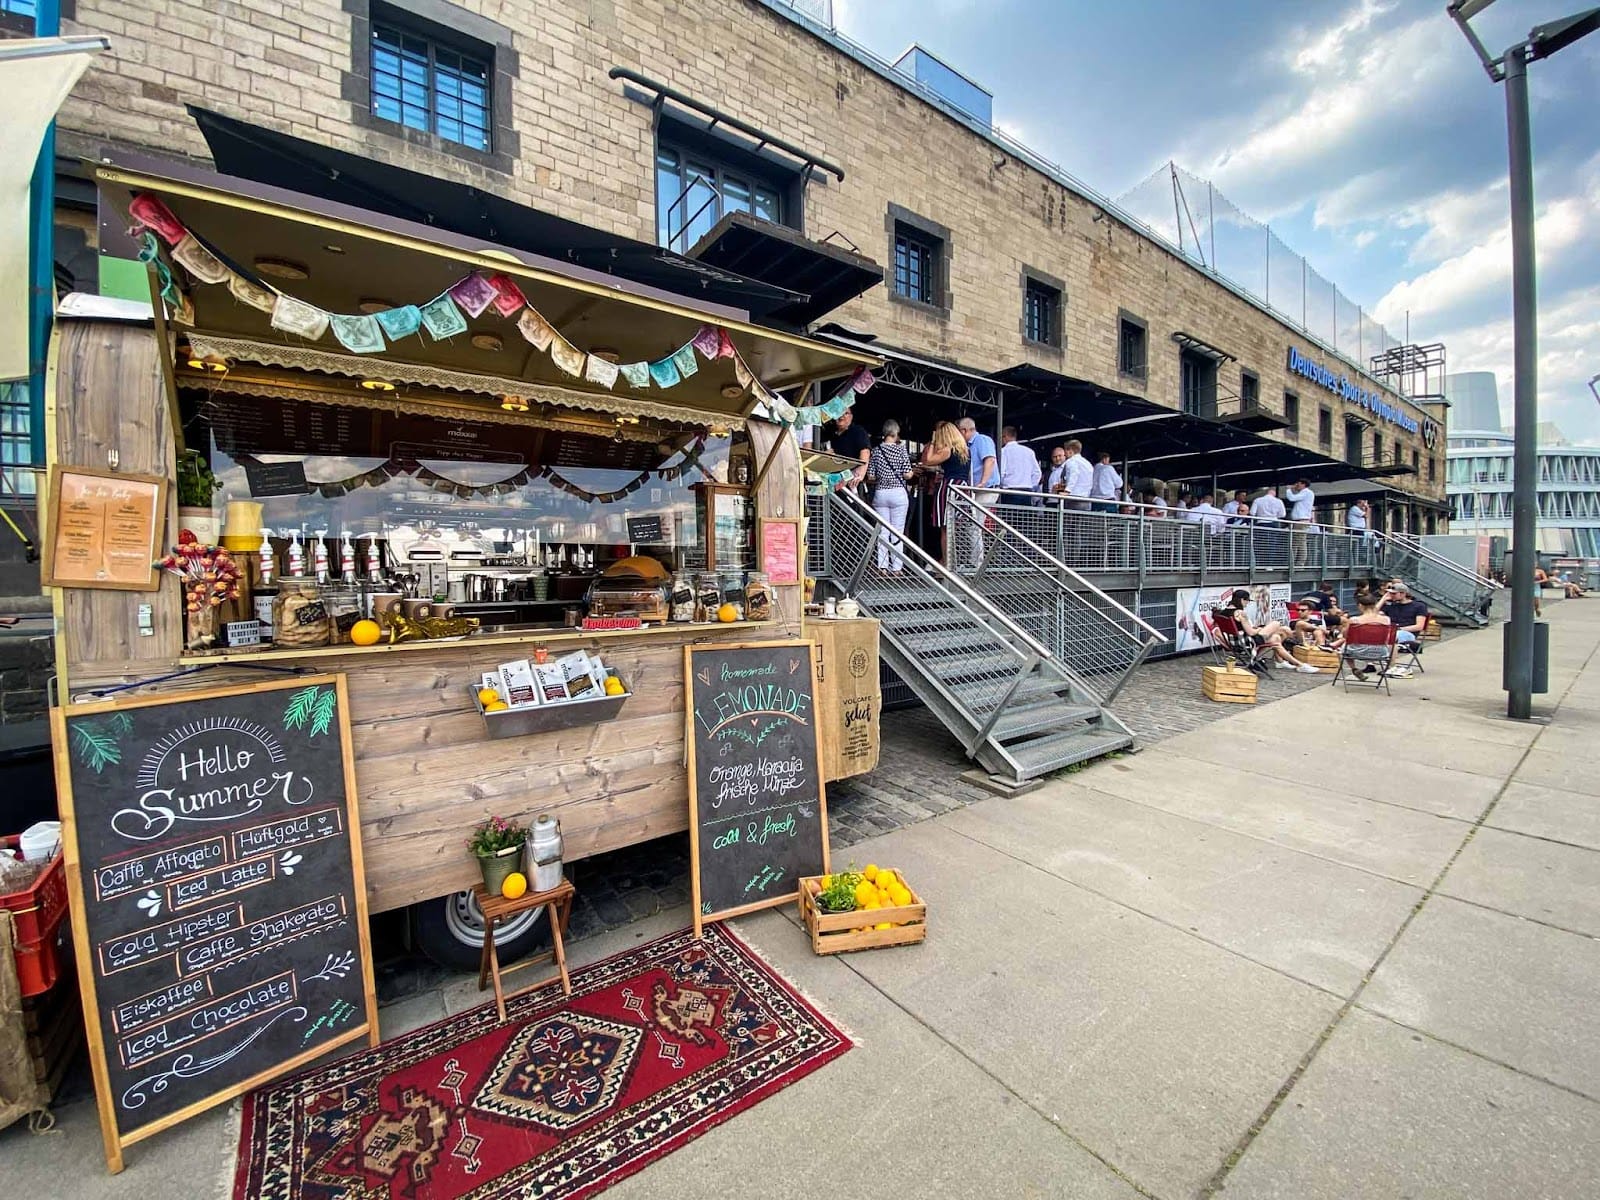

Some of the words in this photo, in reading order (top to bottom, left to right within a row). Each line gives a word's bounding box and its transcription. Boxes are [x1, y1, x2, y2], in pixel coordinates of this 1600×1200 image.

[1290, 346, 1338, 394] Deutsches
[1341, 375, 1361, 405] Sport
[695, 683, 812, 734] LEMONADE
[177, 744, 255, 781] Hello
[111, 771, 314, 841] Summer
[712, 779, 760, 808] frische
[240, 816, 309, 845] Hüftgold
[746, 821, 759, 843] &
[759, 812, 797, 846] fresh
[154, 844, 221, 873] Affogato
[176, 876, 208, 899] Iced
[221, 861, 268, 886] Latte
[108, 932, 156, 959] Cold
[167, 909, 236, 937] Hipster
[250, 902, 336, 942] Shakerato
[119, 979, 203, 1023] Eiskaffee
[126, 1024, 169, 1057] Iced
[191, 980, 290, 1030] Chocolate
